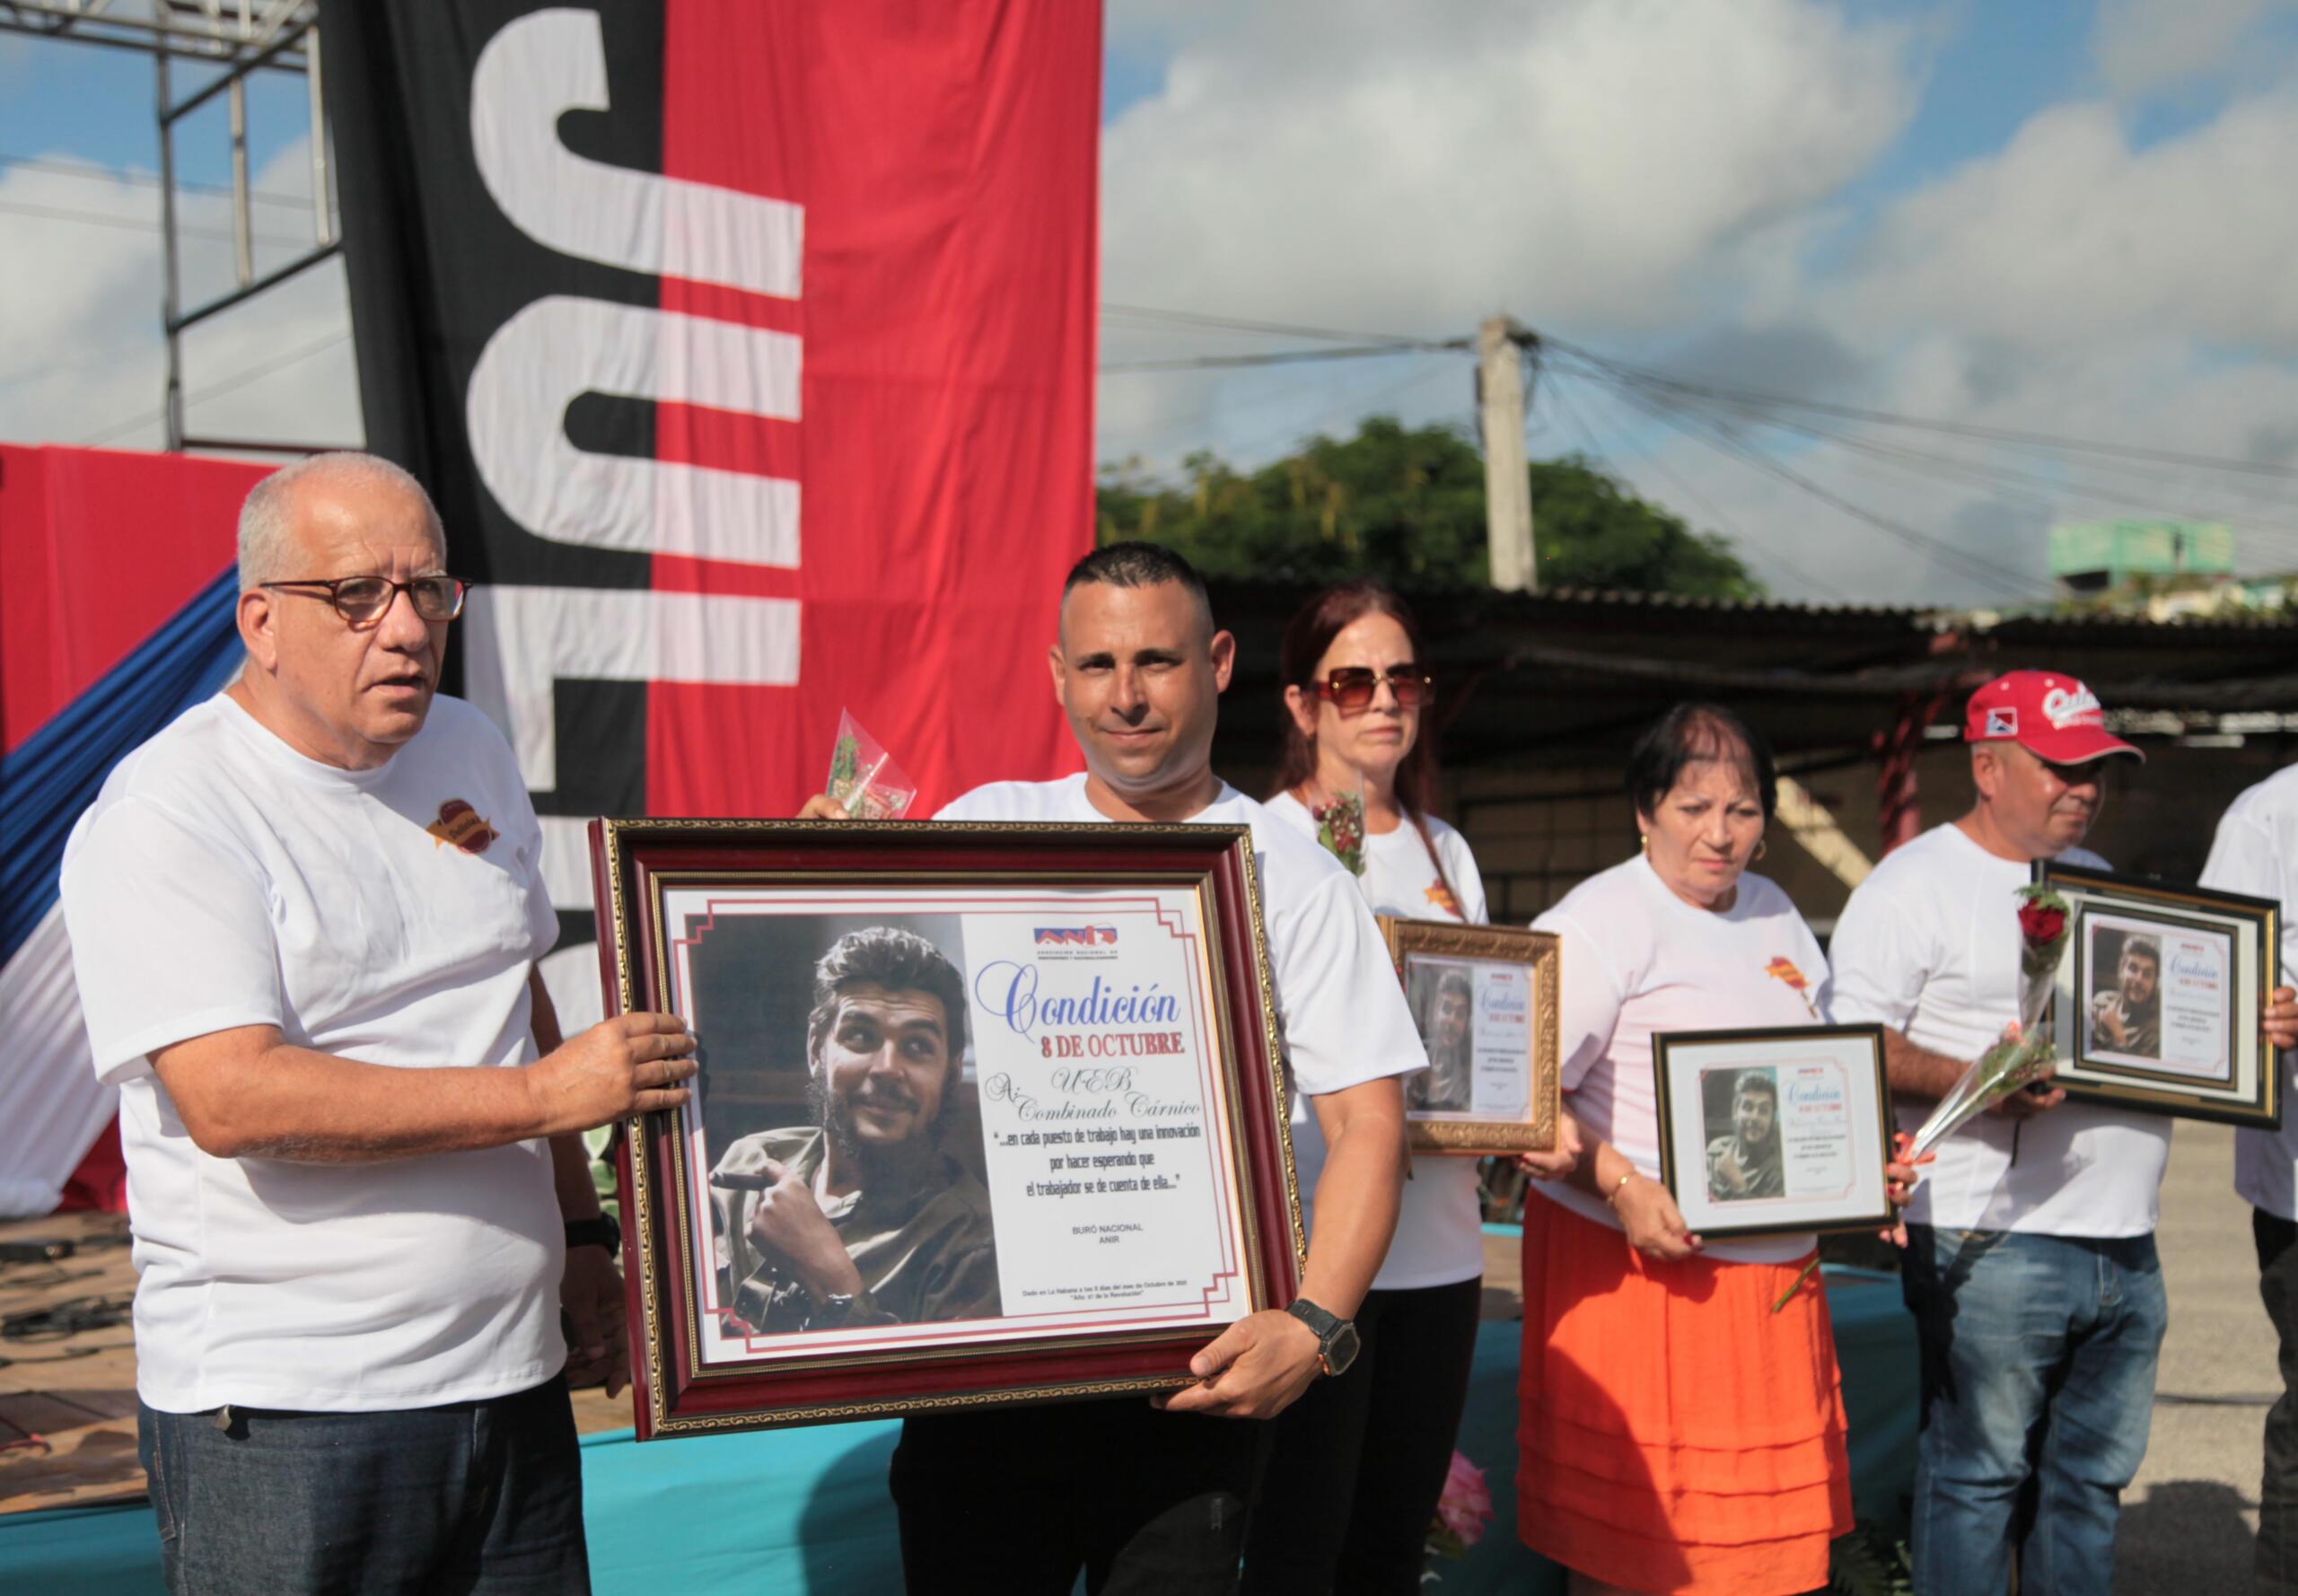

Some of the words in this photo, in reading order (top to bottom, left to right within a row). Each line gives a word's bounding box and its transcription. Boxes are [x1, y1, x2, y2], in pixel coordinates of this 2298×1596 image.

[466, 7, 803, 1039] JUL
[975, 960, 1180, 1043] Condición
[1041, 1036, 1052, 1058] 8
[1056, 1035, 1084, 1057] DE
[1087, 1032, 1185, 1057] OCTUBRE
[1013, 1094, 1119, 1122] Combinado
[1021, 1129, 1040, 1145] cada
[1042, 1129, 1073, 1148] puesto
[1074, 1127, 1085, 1144] de
[1086, 1127, 1118, 1145] trabajo
[1119, 1126, 1136, 1144] hay
[1138, 1127, 1154, 1141] una
[1155, 1122, 1201, 1140] innovación
[1049, 1157, 1064, 1174] por
[1066, 1153, 1090, 1170] hacer
[1092, 1152, 1136, 1171] esperando
[1139, 1153, 1155, 1170] que
[1026, 1180, 1035, 1197] el
[1037, 1179, 1082, 1199] trabajador
[1083, 1181, 1094, 1194] se
[1096, 1178, 1107, 1193] de
[1109, 1178, 1138, 1192] cuenta
[1140, 1176, 1151, 1190] de
[1099, 1223, 1144, 1232] NACIONAL
[1099, 1235, 1120, 1244] ANIR
